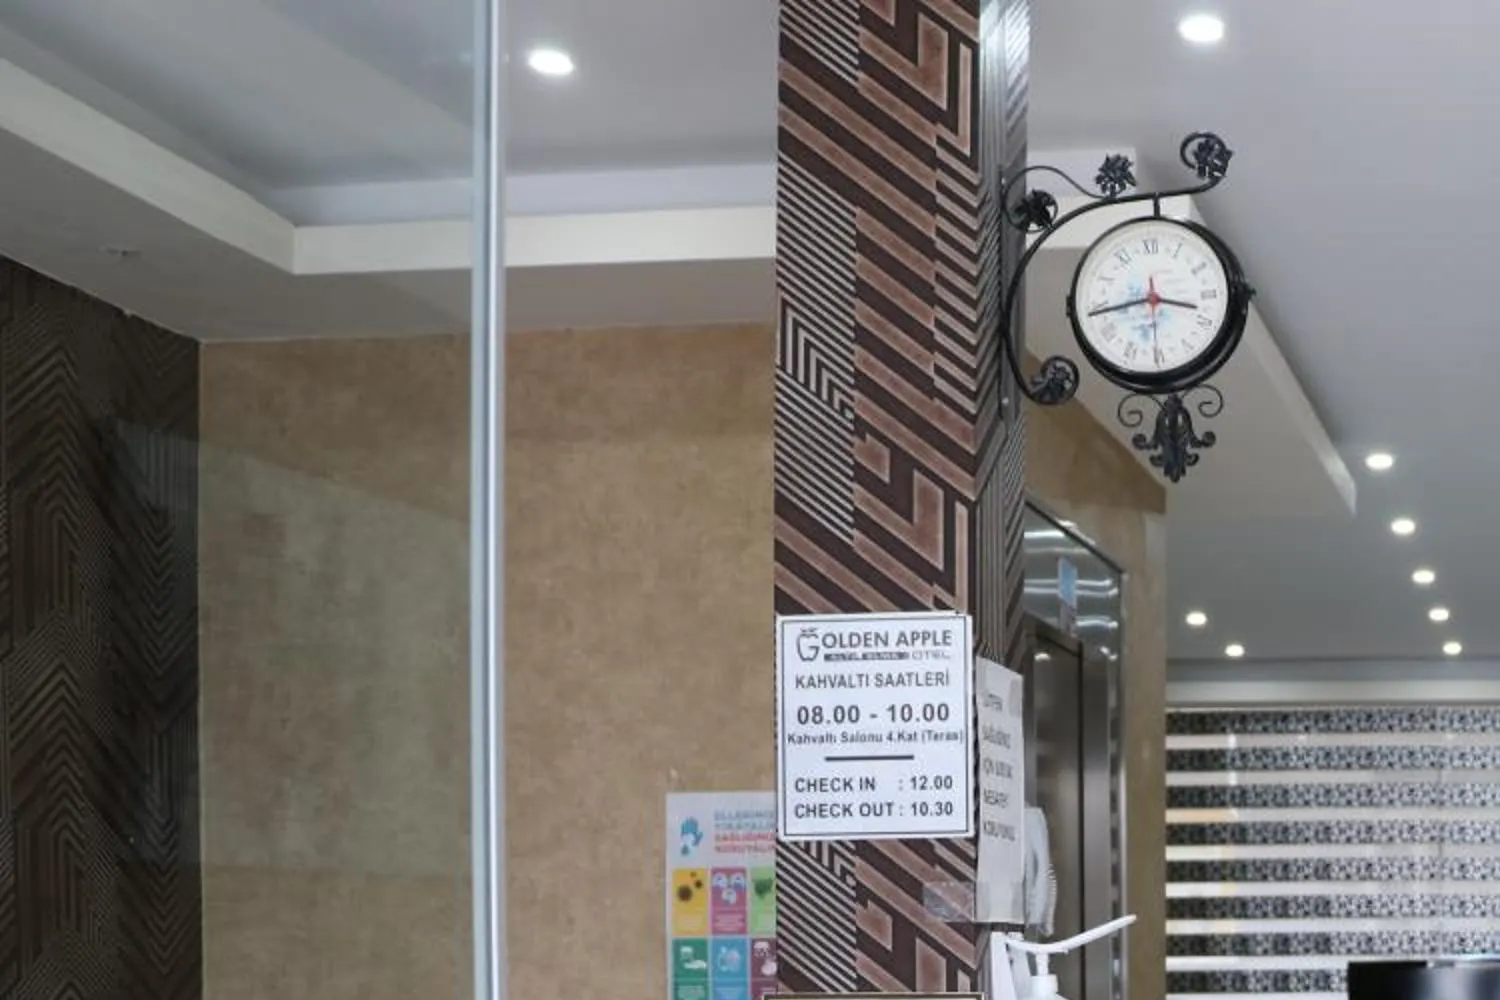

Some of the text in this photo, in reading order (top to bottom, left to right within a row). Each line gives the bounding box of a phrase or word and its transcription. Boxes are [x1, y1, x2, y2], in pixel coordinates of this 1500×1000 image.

[895, 630, 952, 646] APPLE
[795, 667, 950, 689] KAHVALTI SAATLERİ
[797, 704, 861, 725] 08.00
[887, 703, 950, 723] 10.00
[841, 731, 883, 743] Salonu
[795, 777, 854, 793] CHECK
[859, 776, 876, 791] IN
[910, 775, 953, 790] 12.00
[794, 803, 854, 819] CHECK
[859, 802, 893, 817] OUT
[911, 801, 953, 817] 10.30
